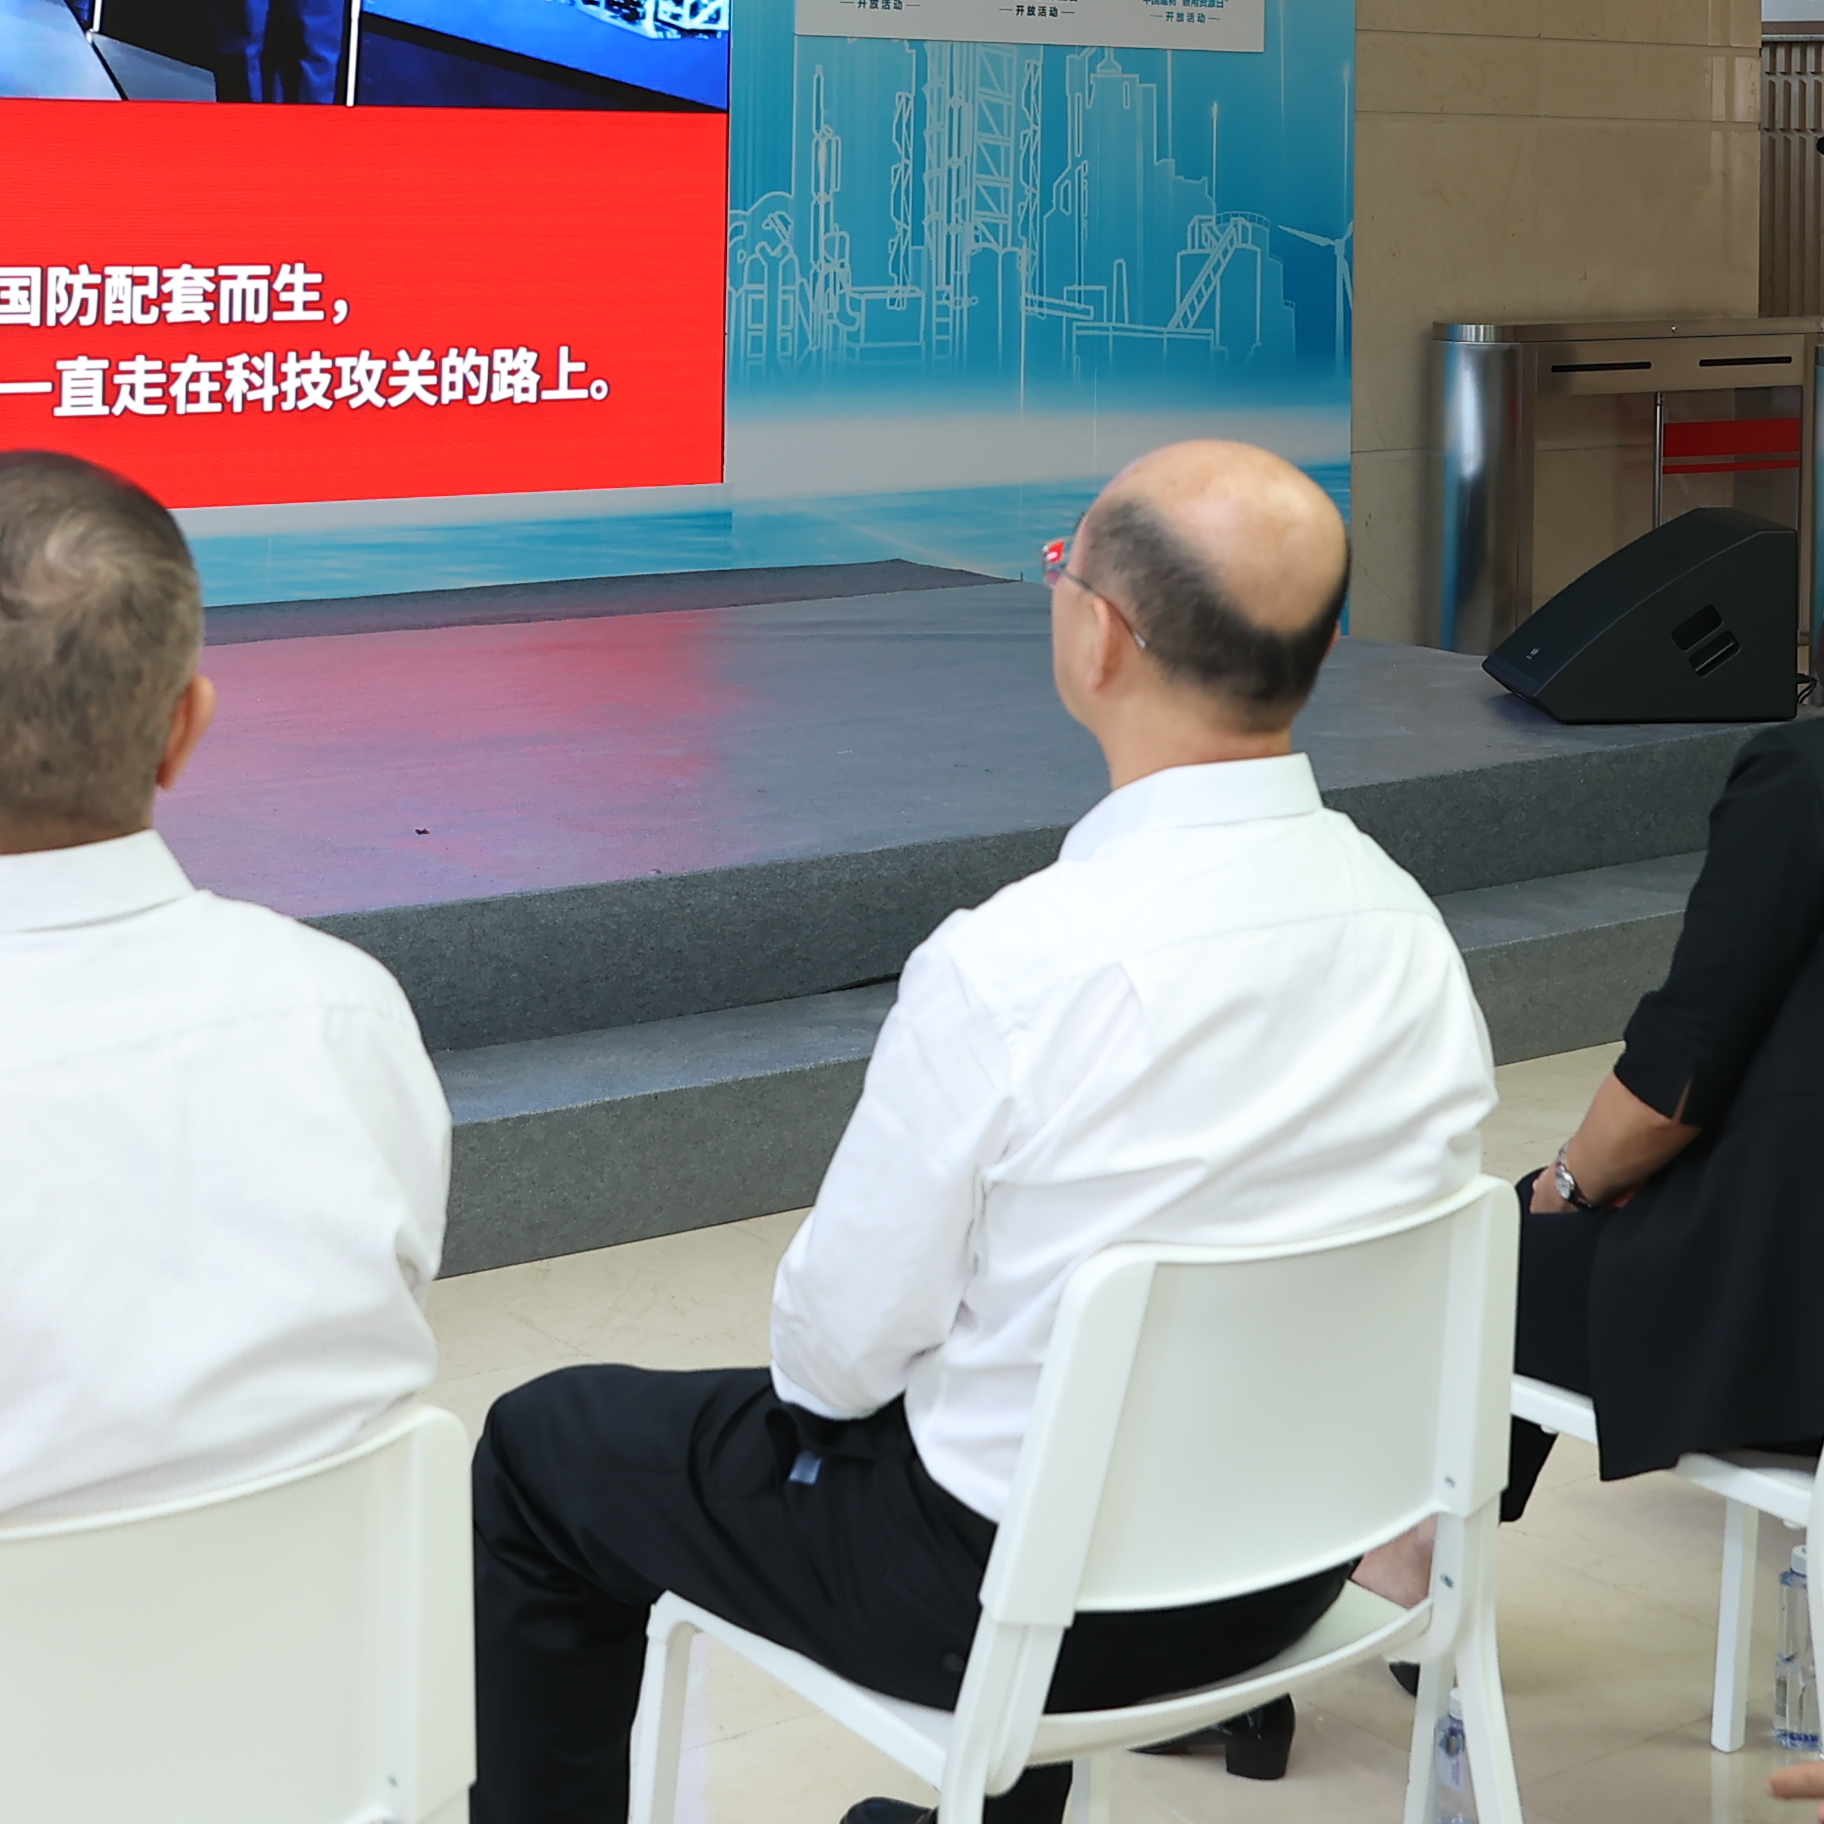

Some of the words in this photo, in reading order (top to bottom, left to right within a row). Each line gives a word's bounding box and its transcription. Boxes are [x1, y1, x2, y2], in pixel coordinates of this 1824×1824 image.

[1015, 5, 1058, 18] 开放活动
[1165, 11, 1206, 24] 开放活动
